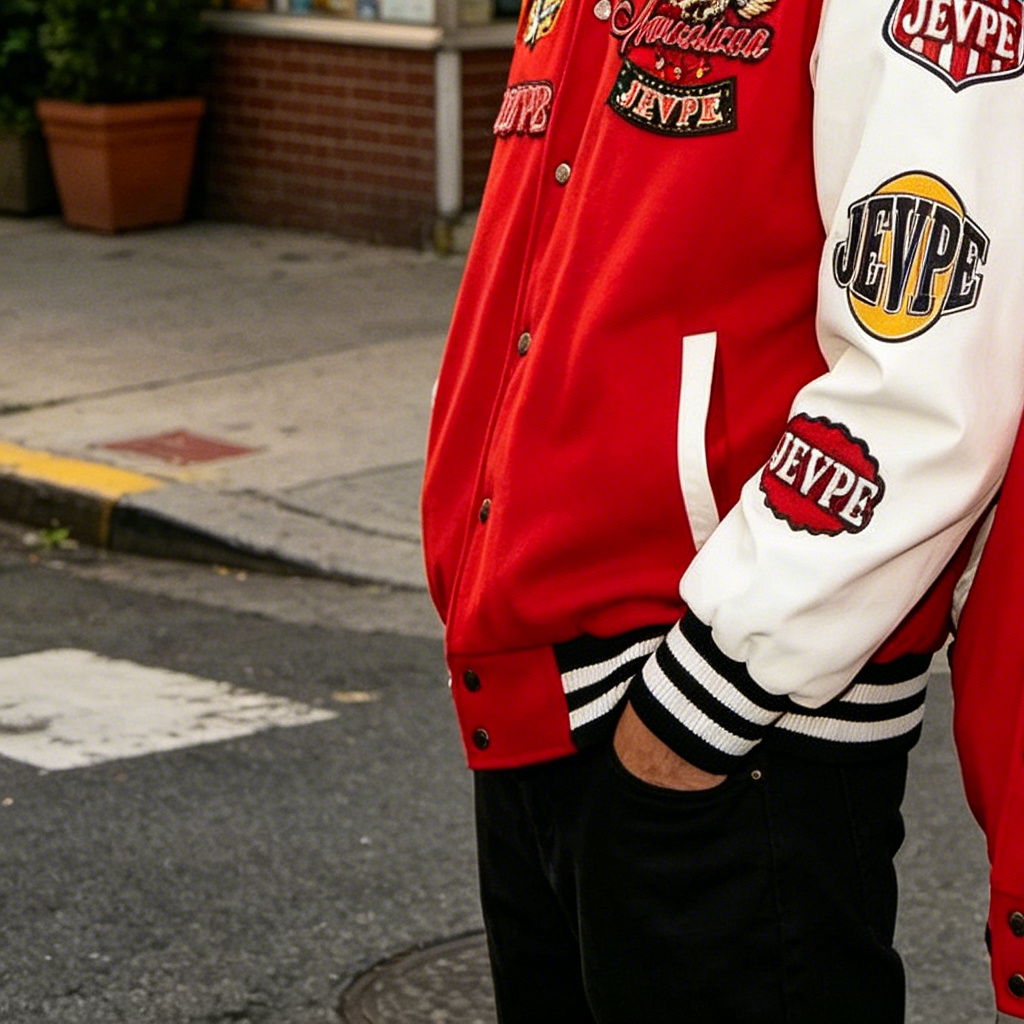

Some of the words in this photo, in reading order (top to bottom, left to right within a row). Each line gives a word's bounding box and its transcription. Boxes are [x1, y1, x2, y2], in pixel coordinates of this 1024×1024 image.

[616, 79, 724, 127] JEVPE
[833, 193, 990, 317] JEVPE
[769, 431, 880, 527] JEVPE
